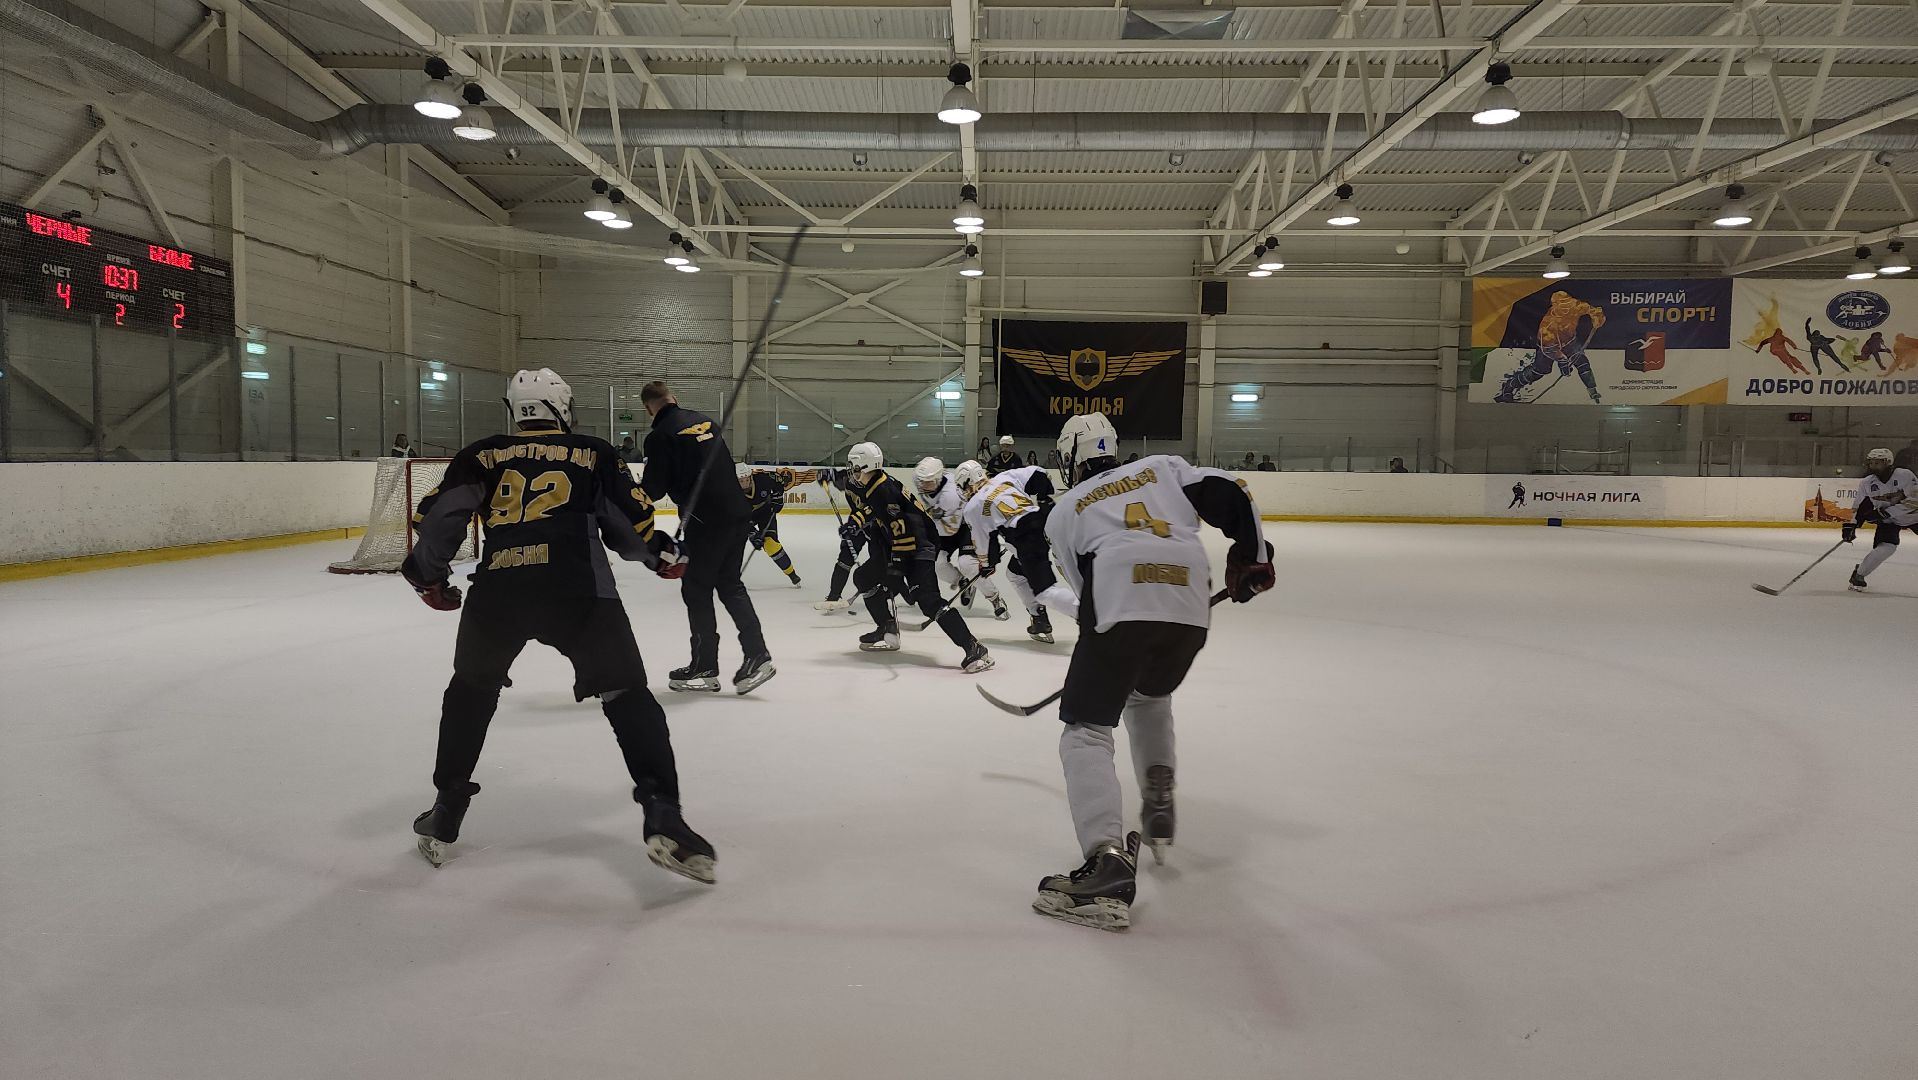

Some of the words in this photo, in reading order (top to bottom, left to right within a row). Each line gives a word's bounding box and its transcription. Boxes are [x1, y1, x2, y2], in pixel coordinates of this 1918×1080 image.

[25, 212, 92, 246] ЧЕРНЫЕ
[148, 245, 194, 270] БЕЛЫЕ
[42, 263, 71, 278] СЧЕТ
[57, 282, 71, 309] 4
[105, 291, 136, 304] ПЕРИОД
[162, 288, 186, 300] СЧЕТ
[1610, 289, 1686, 304] ВЫБИРАЙ
[116, 303, 125, 325] 2
[173, 303, 185, 328] 2
[1637, 306, 1716, 323] СПОРТ!
[1841, 320, 1873, 328] ЛОБНЯ
[1746, 379, 1814, 396] ДОБРО
[1819, 379, 1918, 395] ПОЖАЛОВ
[521, 406, 537, 416] 92
[1050, 396, 1124, 415] КРЫЛЬЯ
[1097, 438, 1106, 451] 4
[486, 469, 572, 528] 92
[1533, 492, 1597, 502] НОЧНАЯ
[1601, 492, 1641, 502] ЛИГА
[1836, 490, 1846, 498] ОТ
[1125, 502, 1172, 538] 4
